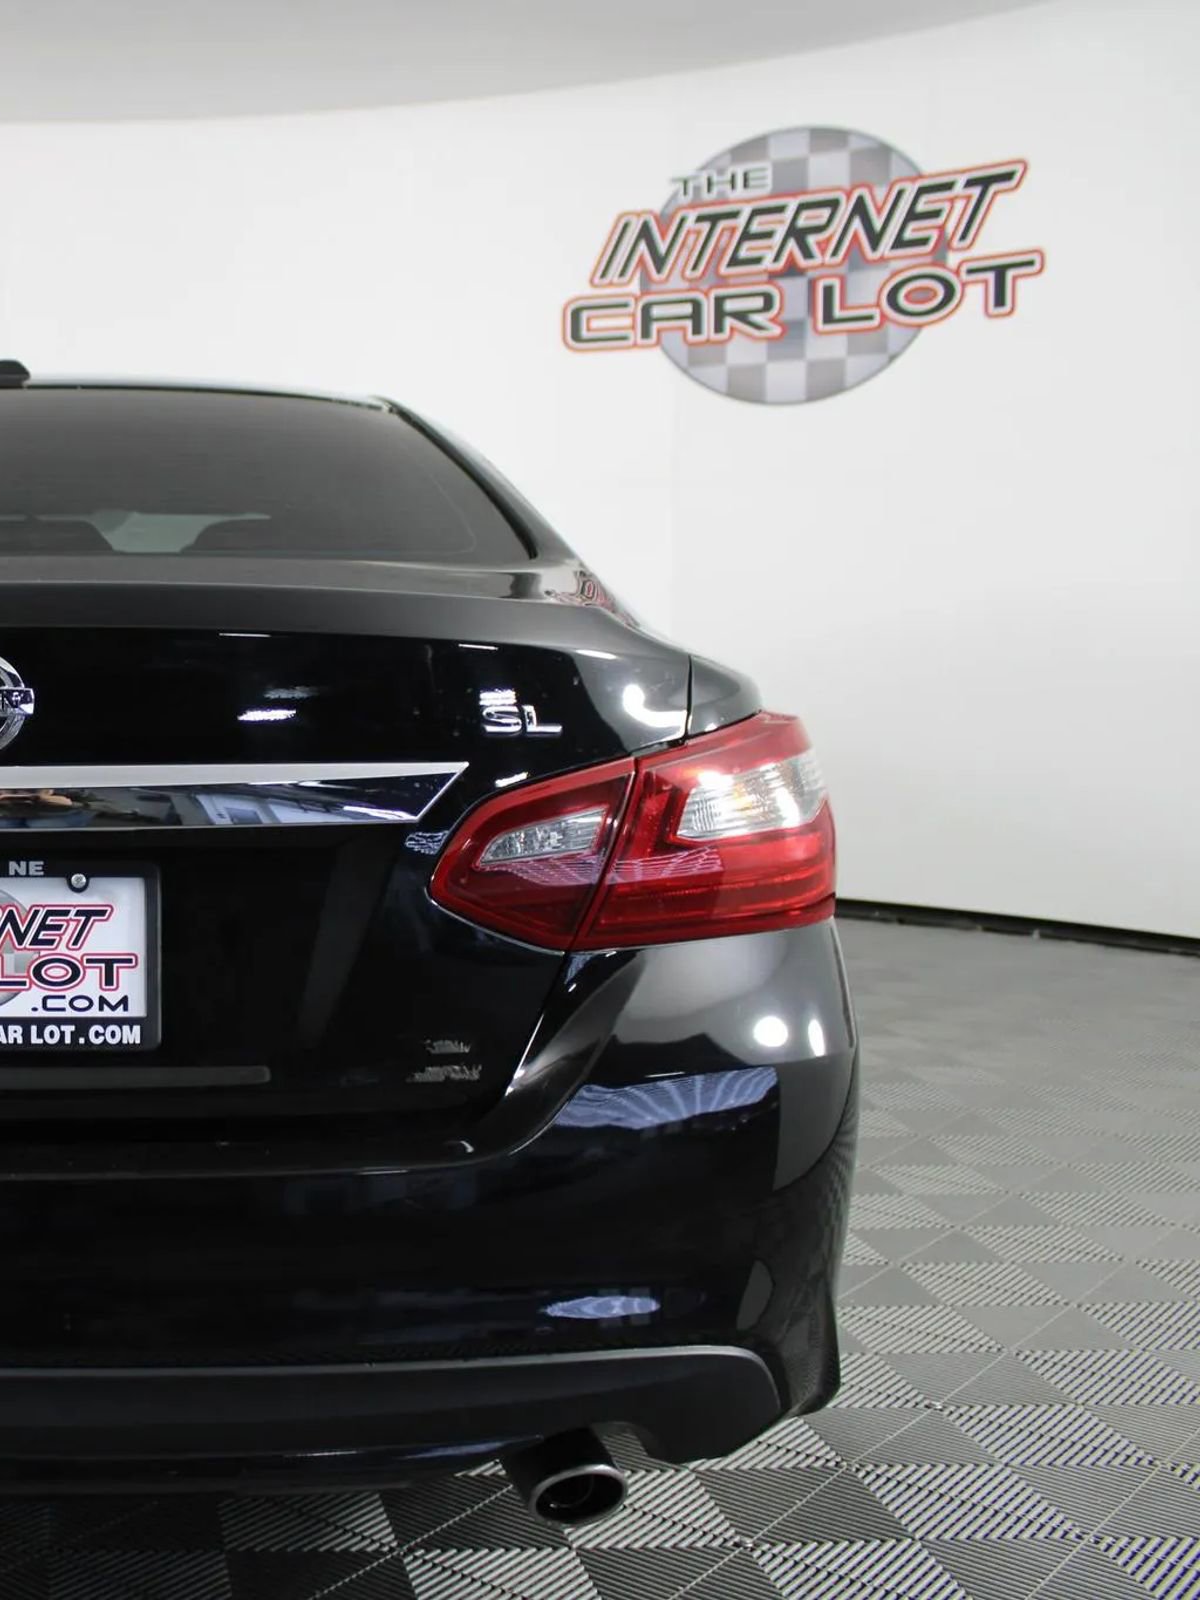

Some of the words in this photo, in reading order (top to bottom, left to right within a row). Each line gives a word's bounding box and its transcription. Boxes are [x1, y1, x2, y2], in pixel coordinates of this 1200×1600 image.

[671, 165, 771, 197] THE
[595, 162, 1025, 282] INTERNET
[566, 284, 781, 347] CAR
[817, 255, 1039, 329] LOT
[482, 704, 563, 734] SL
[8, 861, 44, 876] NE
[31, 995, 129, 1013] .COM
[30, 1024, 72, 1044] LOT
